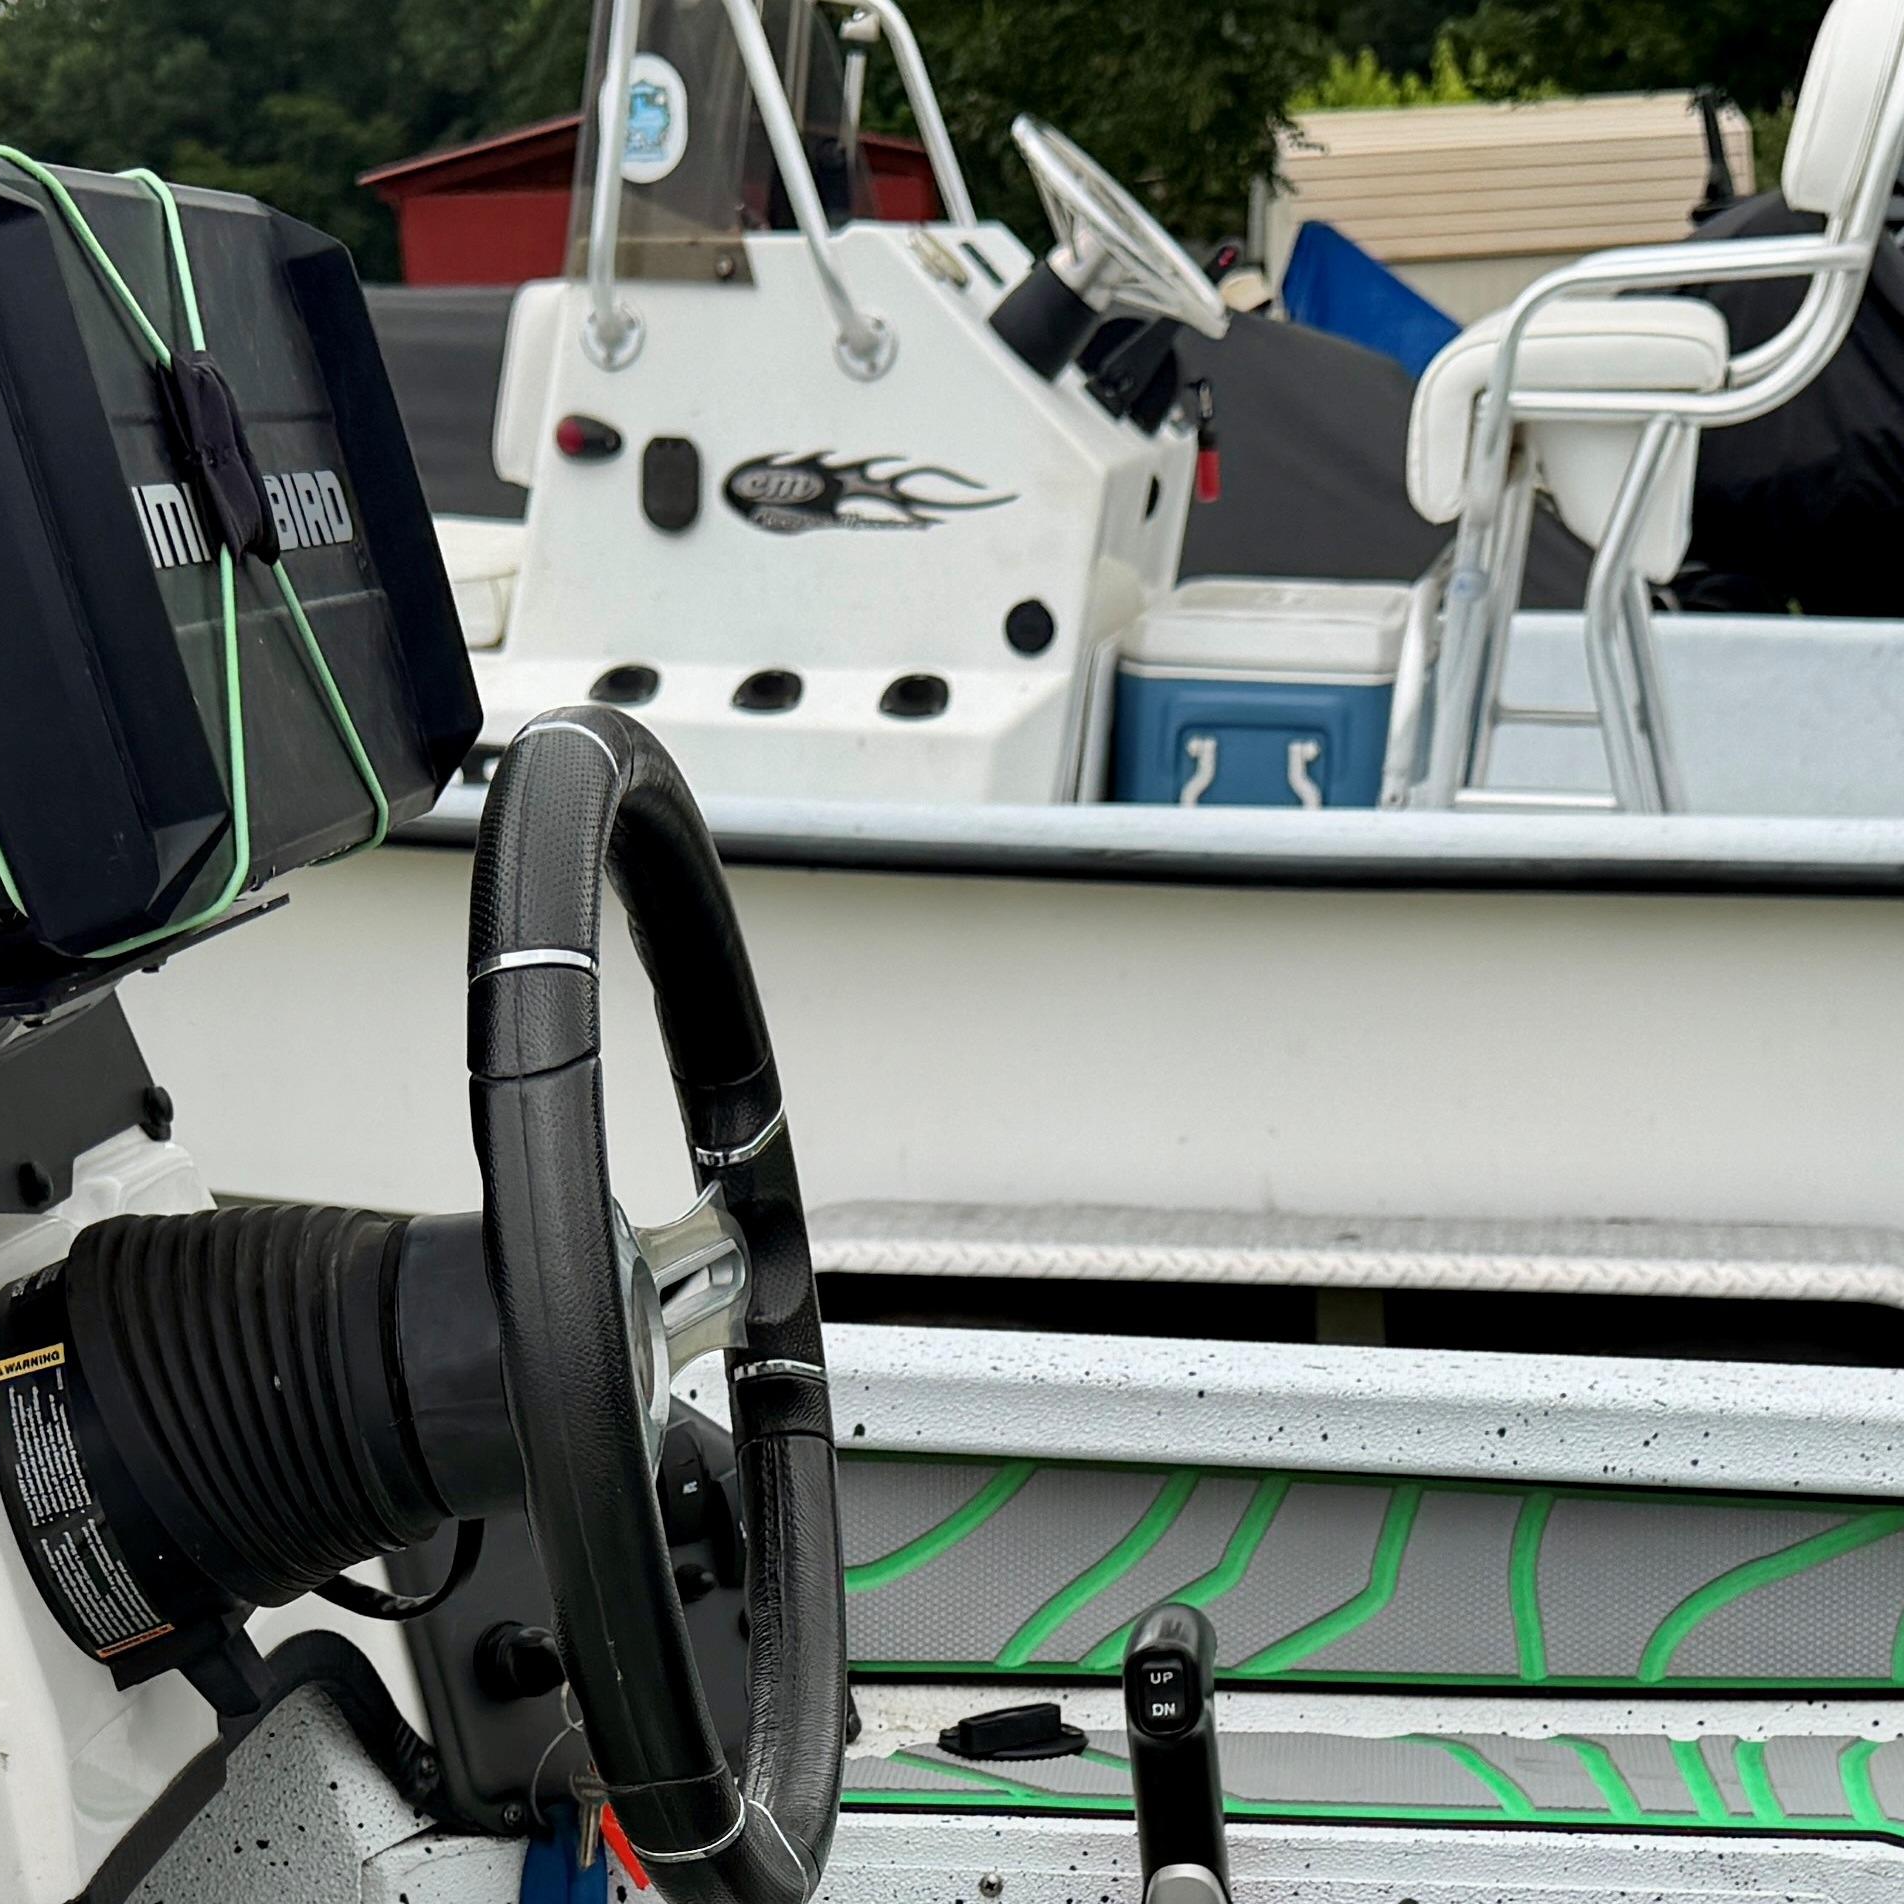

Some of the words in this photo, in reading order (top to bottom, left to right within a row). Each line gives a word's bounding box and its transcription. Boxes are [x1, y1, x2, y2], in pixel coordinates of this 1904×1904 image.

[4, 1350, 60, 1375] WARNING
[1150, 1671, 1173, 1685] UP
[1152, 1702, 1176, 1717] DN
